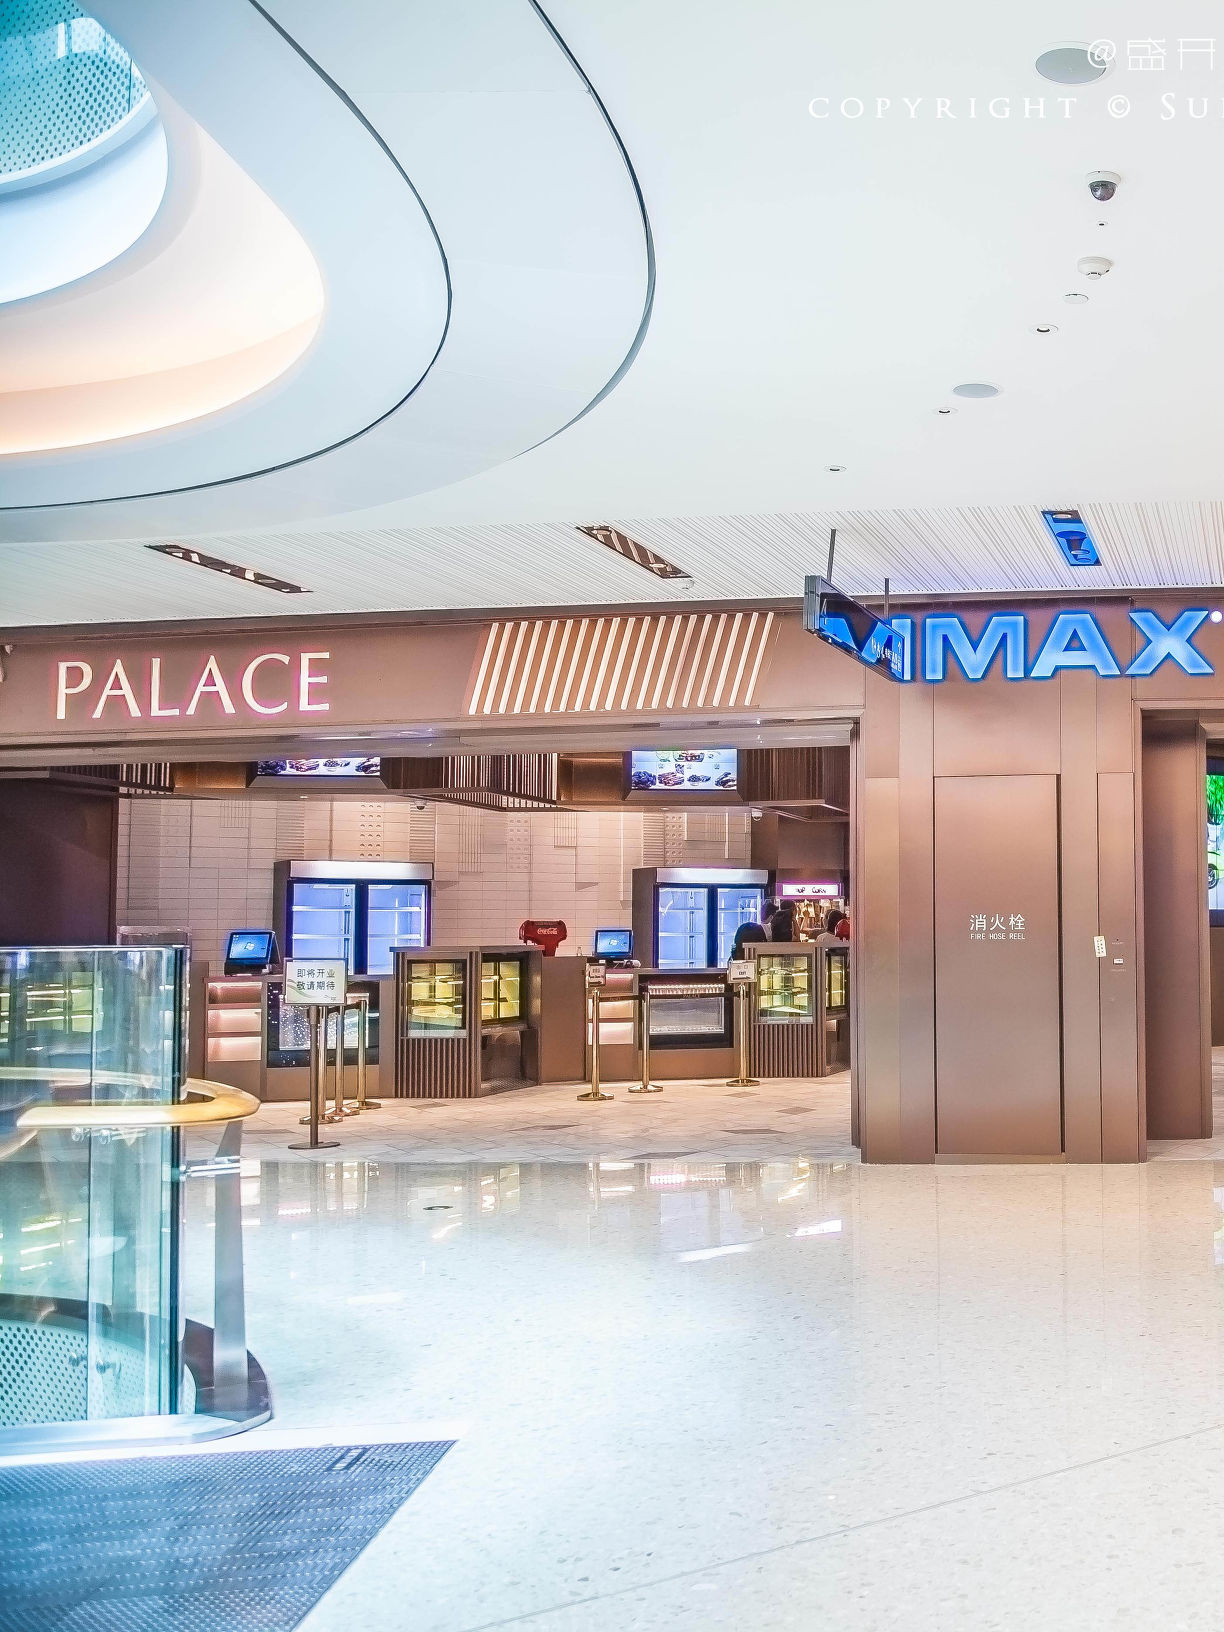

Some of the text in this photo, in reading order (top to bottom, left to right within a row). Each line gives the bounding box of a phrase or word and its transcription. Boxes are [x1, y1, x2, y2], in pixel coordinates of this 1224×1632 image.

[891, 610, 1215, 681] IMAX
[56, 651, 331, 720] PALACE
[969, 913, 1026, 931] 消火栓
[970, 932, 1026, 940] FIRE HOSE REEL
[296, 968, 336, 979] 即将开业
[296, 980, 336, 991] 敬请期待
